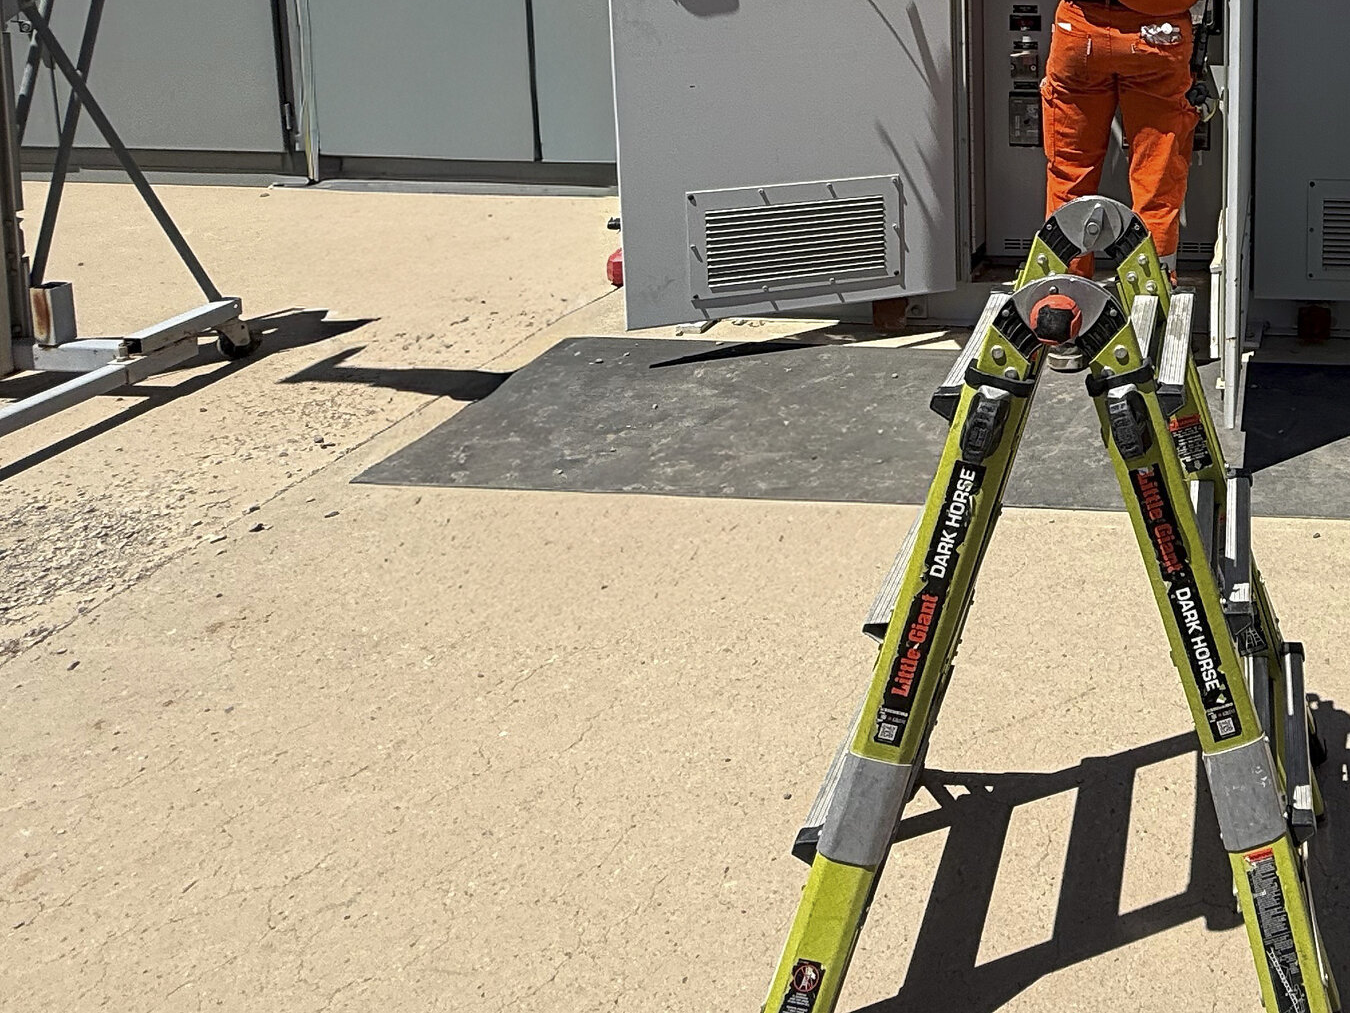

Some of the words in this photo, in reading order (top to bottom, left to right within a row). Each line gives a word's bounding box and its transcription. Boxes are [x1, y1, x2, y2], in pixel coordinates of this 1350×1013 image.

[891, 647, 921, 697] Little
[908, 593, 939, 644] Giant
[929, 529, 957, 579] DARK
[945, 467, 976, 528] HORSE
[1155, 523, 1183, 573] Giant
[1175, 587, 1203, 634] DARK
[1191, 635, 1220, 692] HORSE
